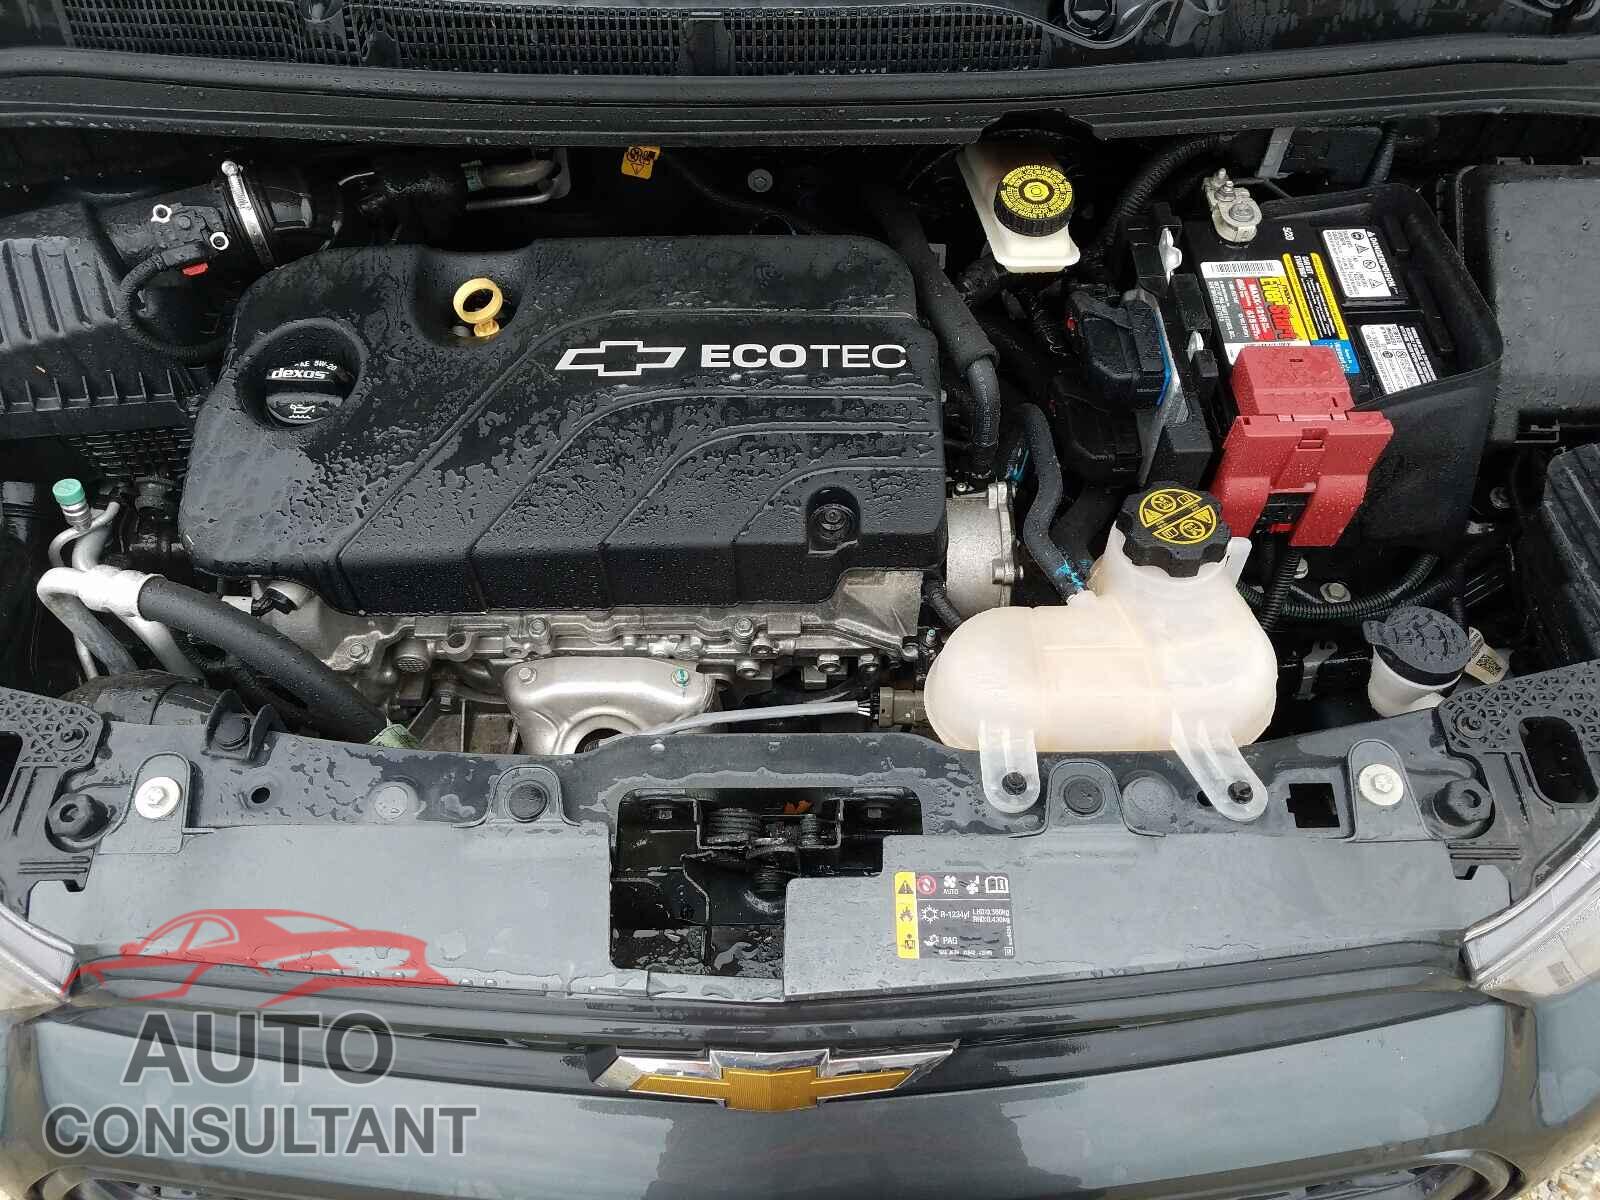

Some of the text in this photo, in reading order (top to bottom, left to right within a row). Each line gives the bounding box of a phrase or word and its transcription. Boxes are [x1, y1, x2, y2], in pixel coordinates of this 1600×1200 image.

[701, 344, 907, 369] ECOTEC
[271, 367, 330, 379] dexos
[943, 936, 958, 945] PAG
